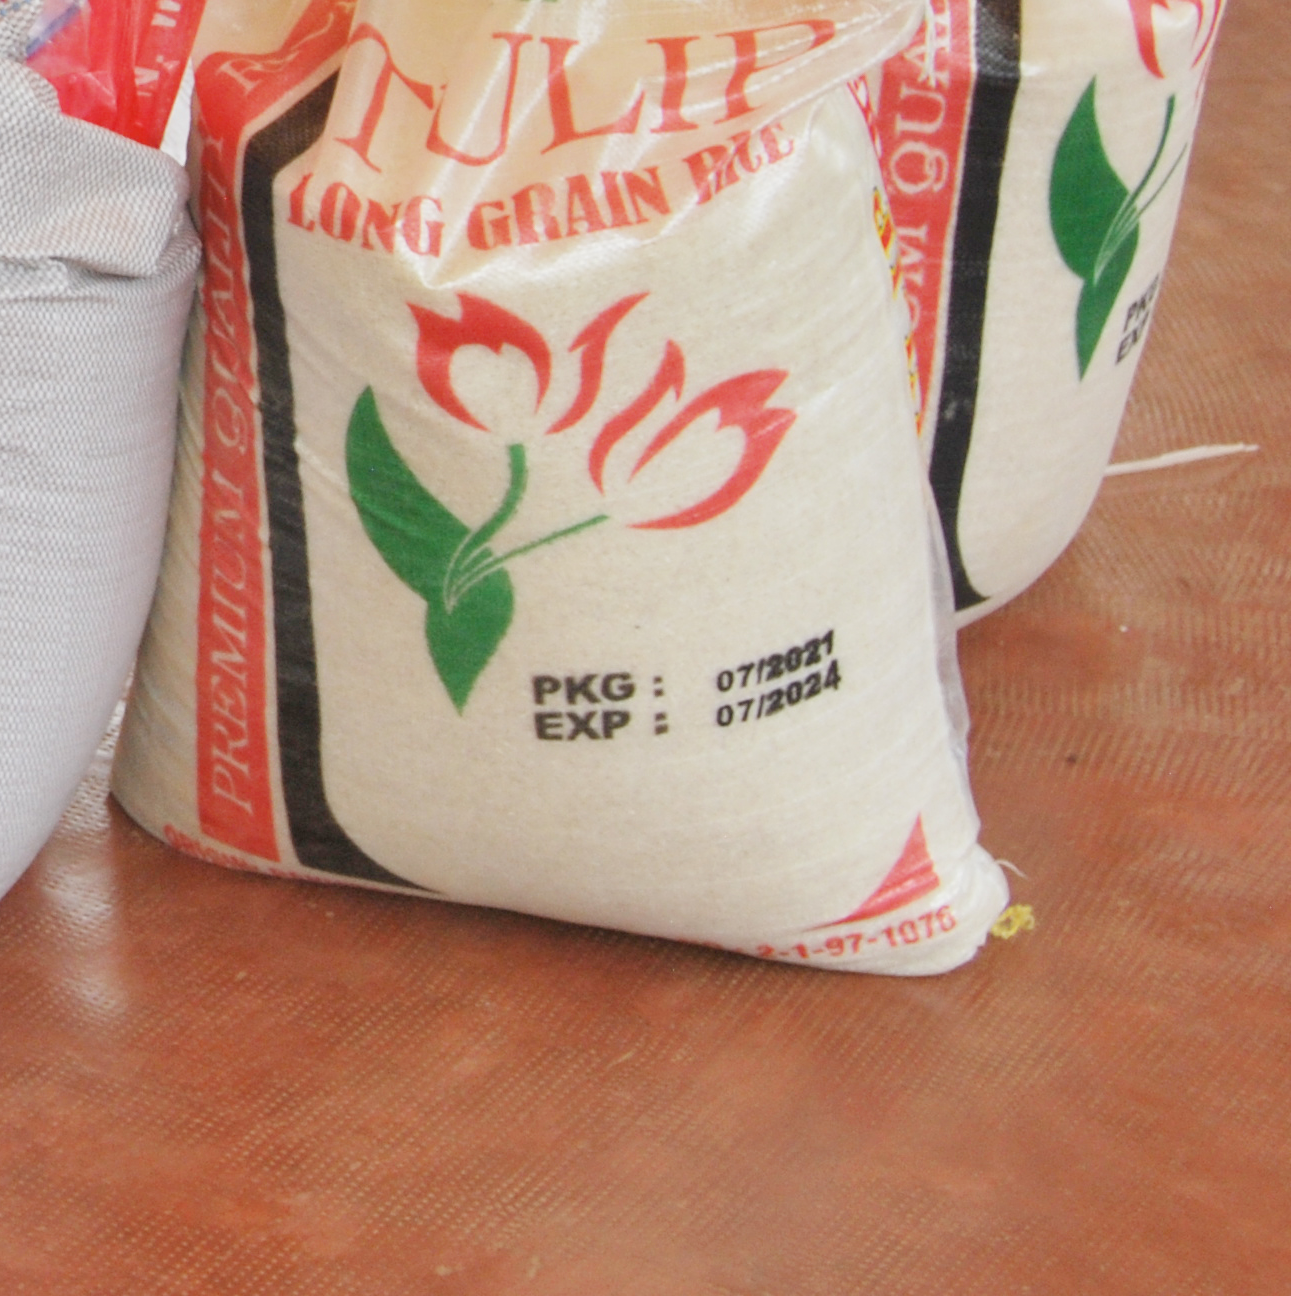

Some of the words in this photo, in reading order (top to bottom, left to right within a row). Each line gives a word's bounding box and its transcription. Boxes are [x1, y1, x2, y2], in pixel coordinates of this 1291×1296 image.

[335, 17, 838, 174] TULIP
[287, 172, 444, 258] LONG
[466, 166, 673, 252] GRAIN
[210, 468, 252, 814] PREMIUM
[532, 673, 636, 705] PKG
[717, 630, 835, 694] 07/2021
[534, 711, 630, 741] EXP
[716, 659, 841, 727] 07/2024
